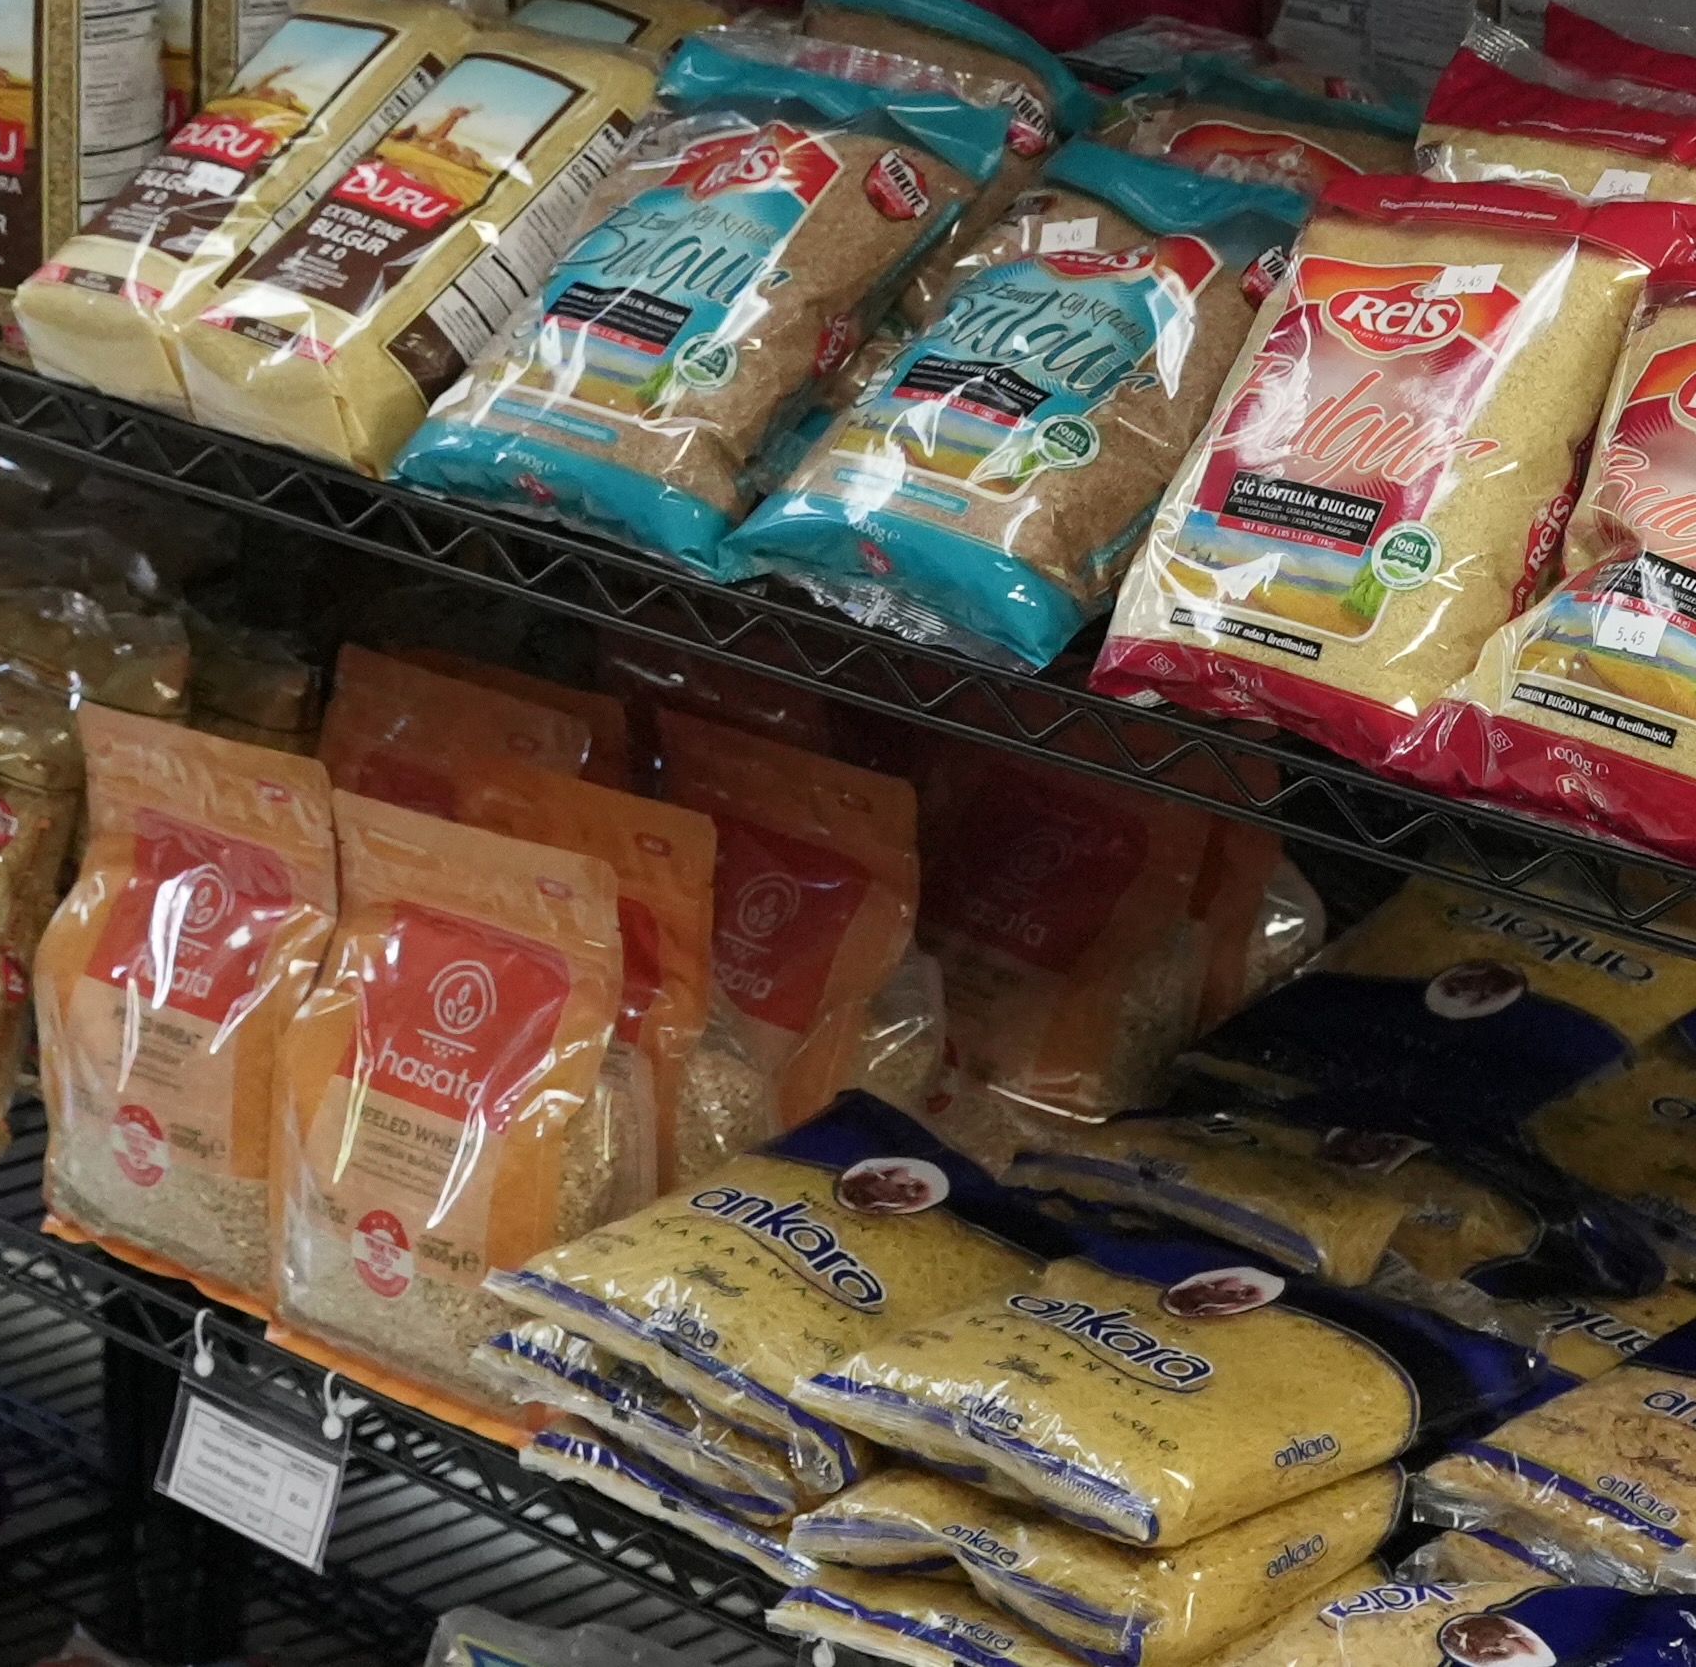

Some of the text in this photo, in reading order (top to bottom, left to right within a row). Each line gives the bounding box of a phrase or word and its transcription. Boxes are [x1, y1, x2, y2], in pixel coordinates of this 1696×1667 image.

[173, 120, 262, 160] DURU
[338, 163, 452, 221] DURU
[307, 219, 390, 258] BULGUR
[320, 203, 370, 232] EXTRA
[1457, 274, 1483, 289] 5.45
[1338, 290, 1457, 338] Reis
[1206, 352, 1503, 486] Bulgur
[1233, 479, 1256, 497] ÇİĞ
[1257, 483, 1317, 513] KÖFTELİK
[1319, 497, 1376, 524] BULGUR
[1526, 499, 1571, 573] Reis
[1267, 631, 1319, 659] üretilmiştir.
[1616, 625, 1646, 647] 5.45
[1514, 686, 1546, 710] DURUM
[1589, 706, 1615, 726] ndan
[1615, 714, 1674, 747] üretilmiştir.
[688, 1185, 888, 1308] ankara
[1008, 1293, 1214, 1387] ankara
[1274, 1433, 1339, 1469] ankara
[1596, 1473, 1681, 1529] ankara
[942, 1523, 1021, 1568] ankara
[1267, 1534, 1326, 1579] ankara
